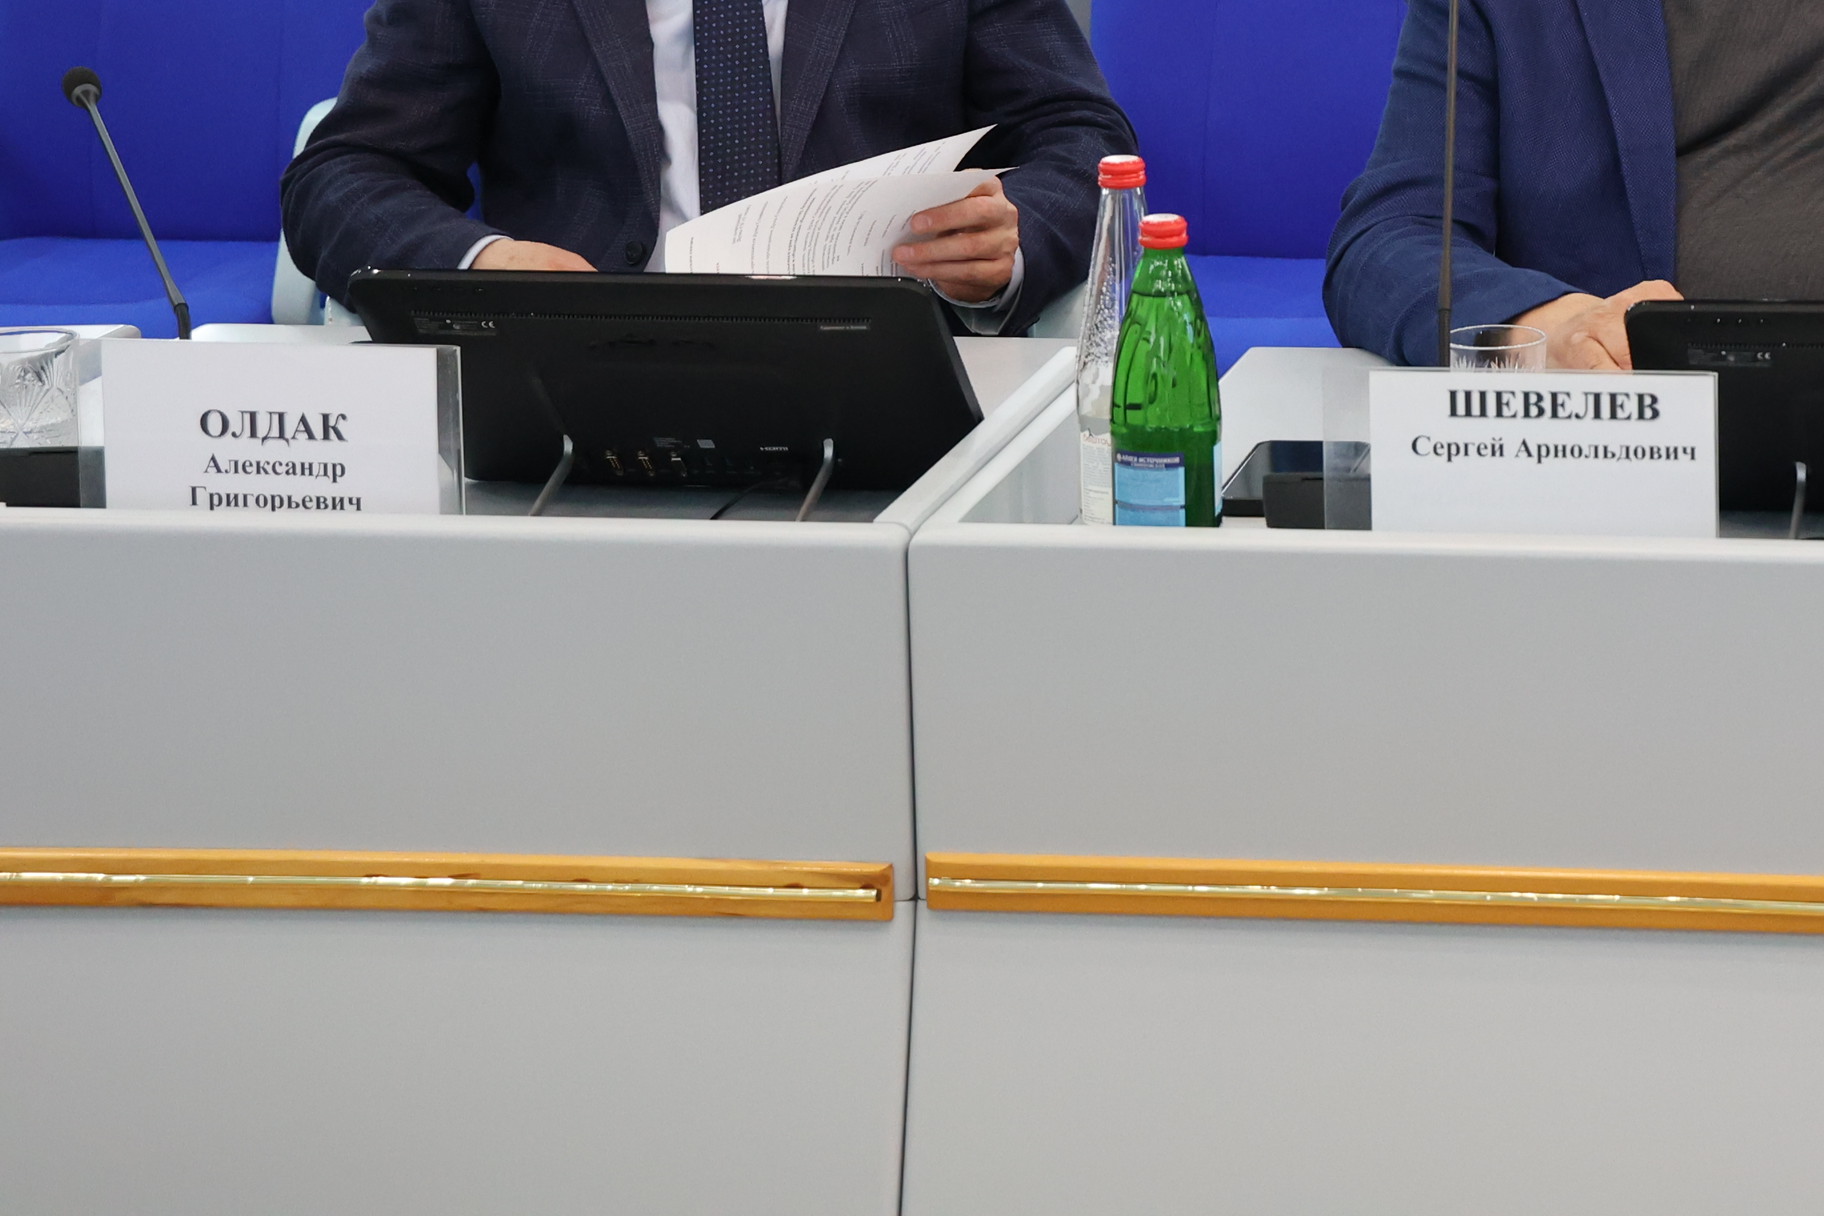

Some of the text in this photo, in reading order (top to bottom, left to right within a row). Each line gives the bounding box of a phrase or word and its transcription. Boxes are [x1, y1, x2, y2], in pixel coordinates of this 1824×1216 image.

[1448, 389, 1661, 422] ШЕВЕЛЕВ
[199, 409, 348, 446] ОЛДАК
[1411, 435, 1697, 465] Сергей Арнольдович
[203, 453, 346, 484] Александр
[189, 485, 362, 512] Григорьевич
